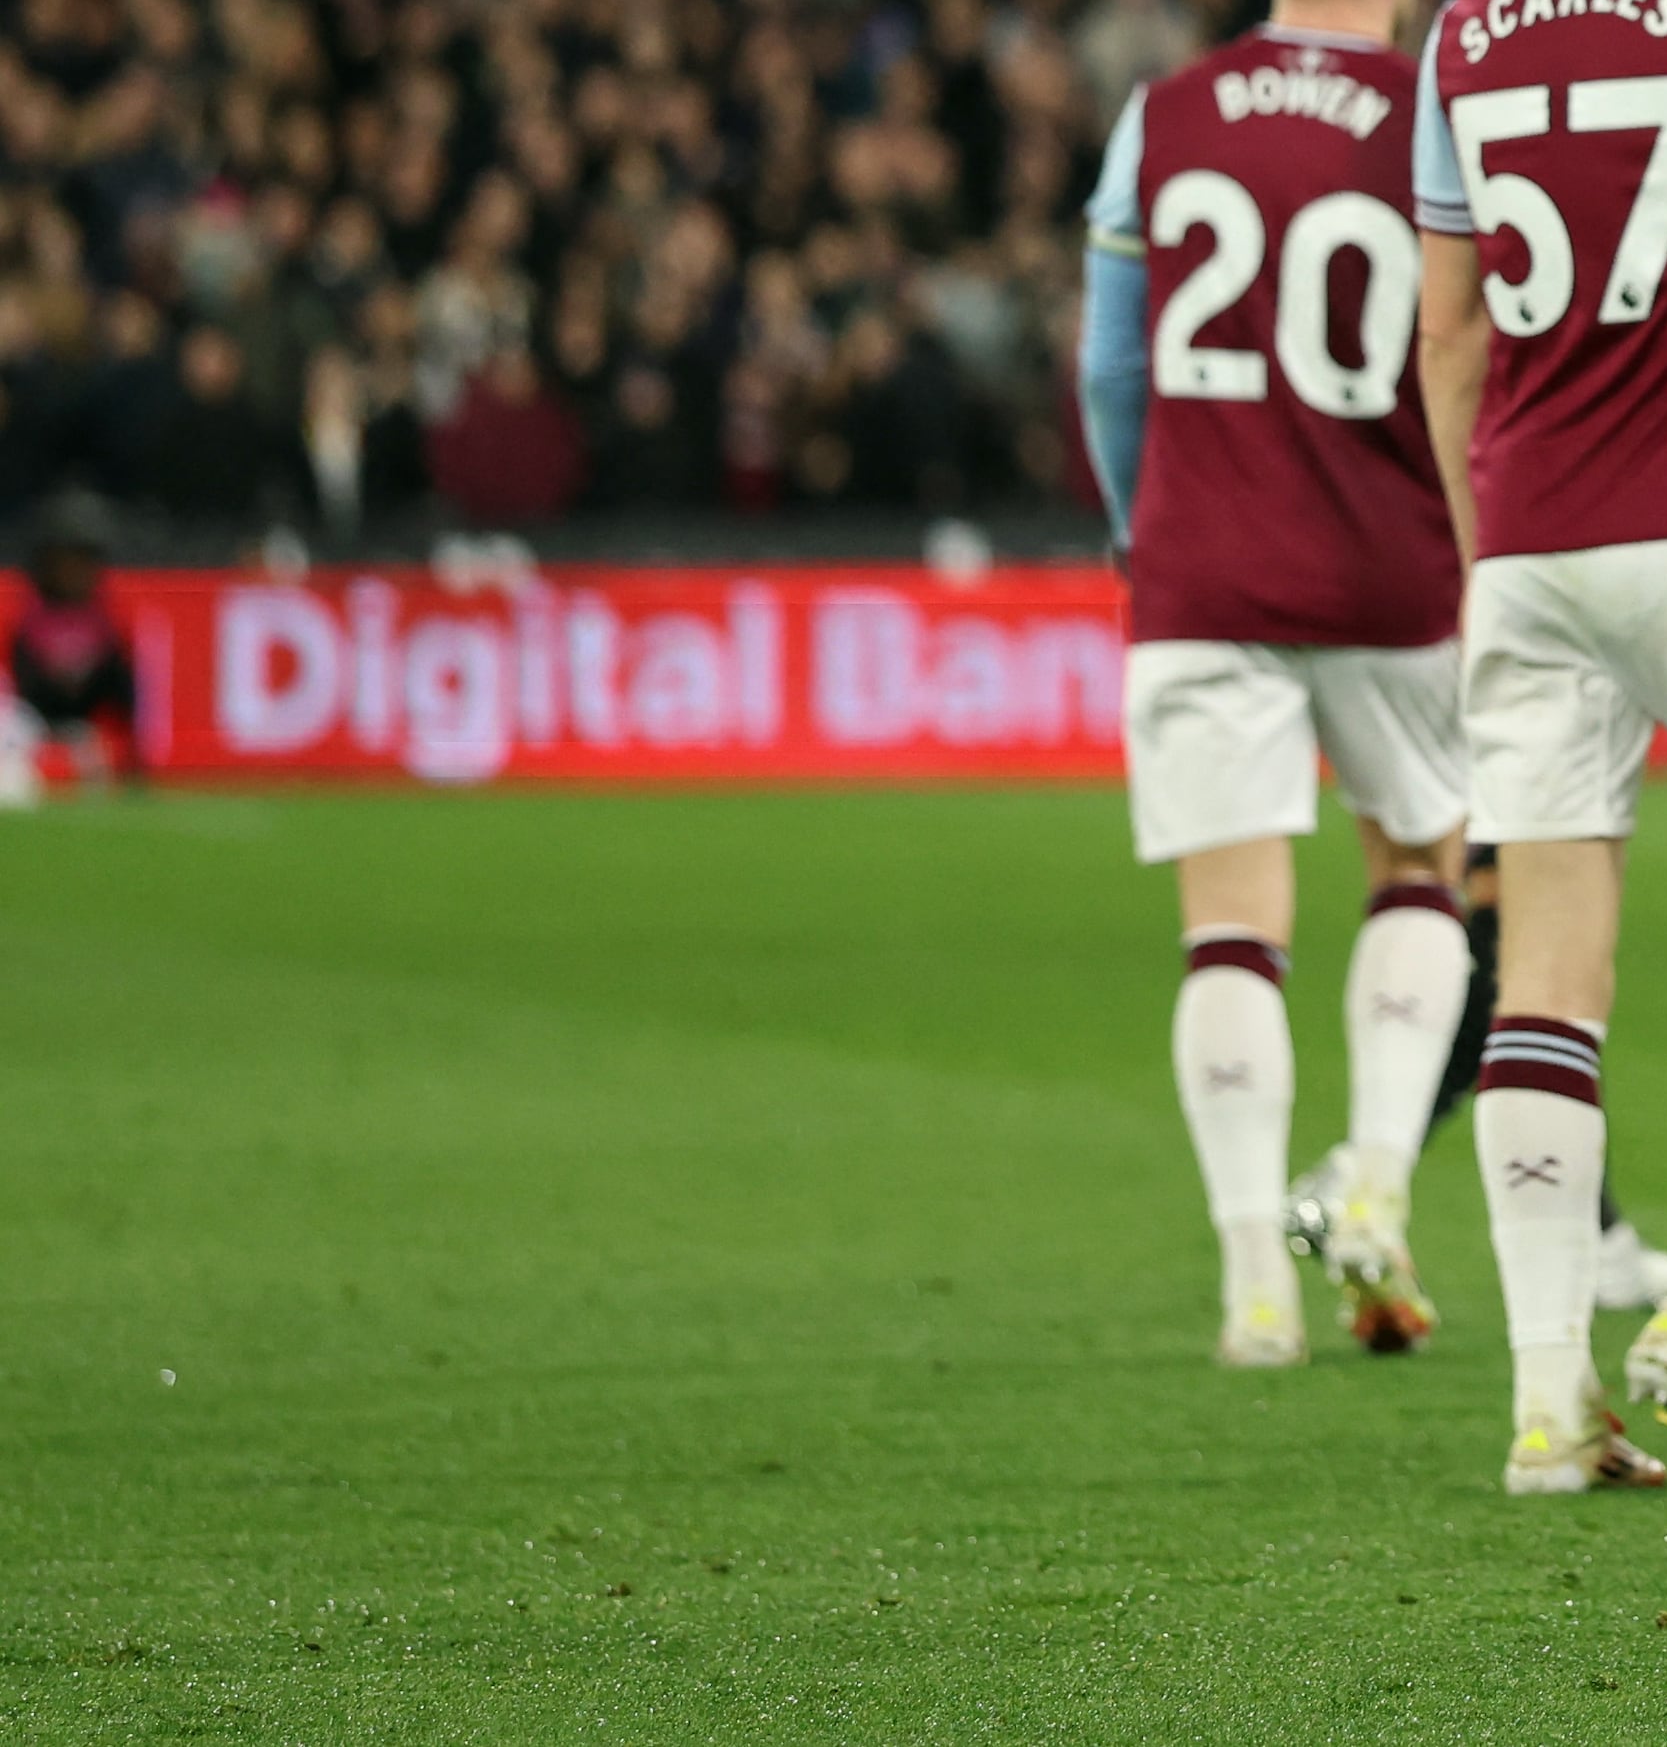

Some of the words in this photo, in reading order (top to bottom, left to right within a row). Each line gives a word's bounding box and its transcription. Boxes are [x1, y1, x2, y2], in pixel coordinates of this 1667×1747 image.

[1213, 64, 1393, 142] BOWEN
[1151, 169, 1422, 420] 20
[216, 582, 784, 782] Digital
[810, 586, 1123, 753] Ban
